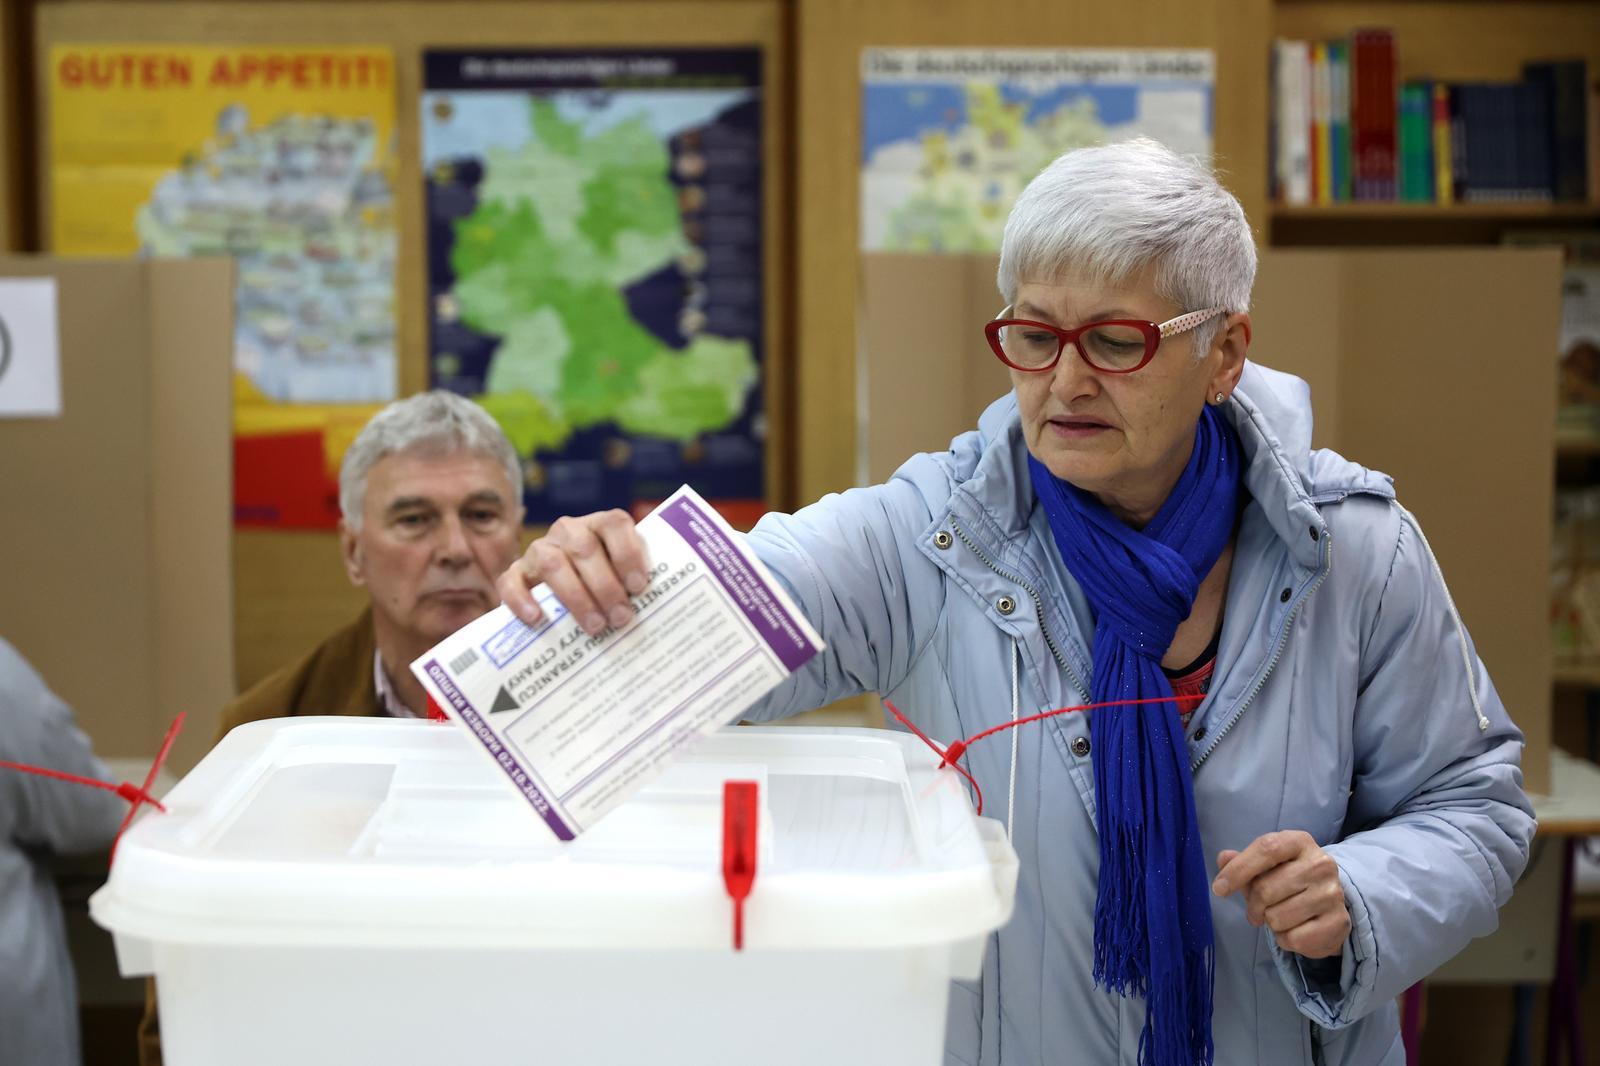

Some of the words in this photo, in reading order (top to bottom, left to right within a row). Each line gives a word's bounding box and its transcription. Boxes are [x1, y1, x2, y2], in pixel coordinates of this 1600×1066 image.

[59, 54, 192, 88] GUTEN
[209, 54, 389, 88] APPETIT!
[630, 559, 697, 615] OKRENITE
[503, 644, 558, 691] СТРАНУ
[515, 646, 587, 706] STRANICU
[426, 663, 467, 709] ОПШТИ
[460, 704, 503, 755] ИЗБОРИ
